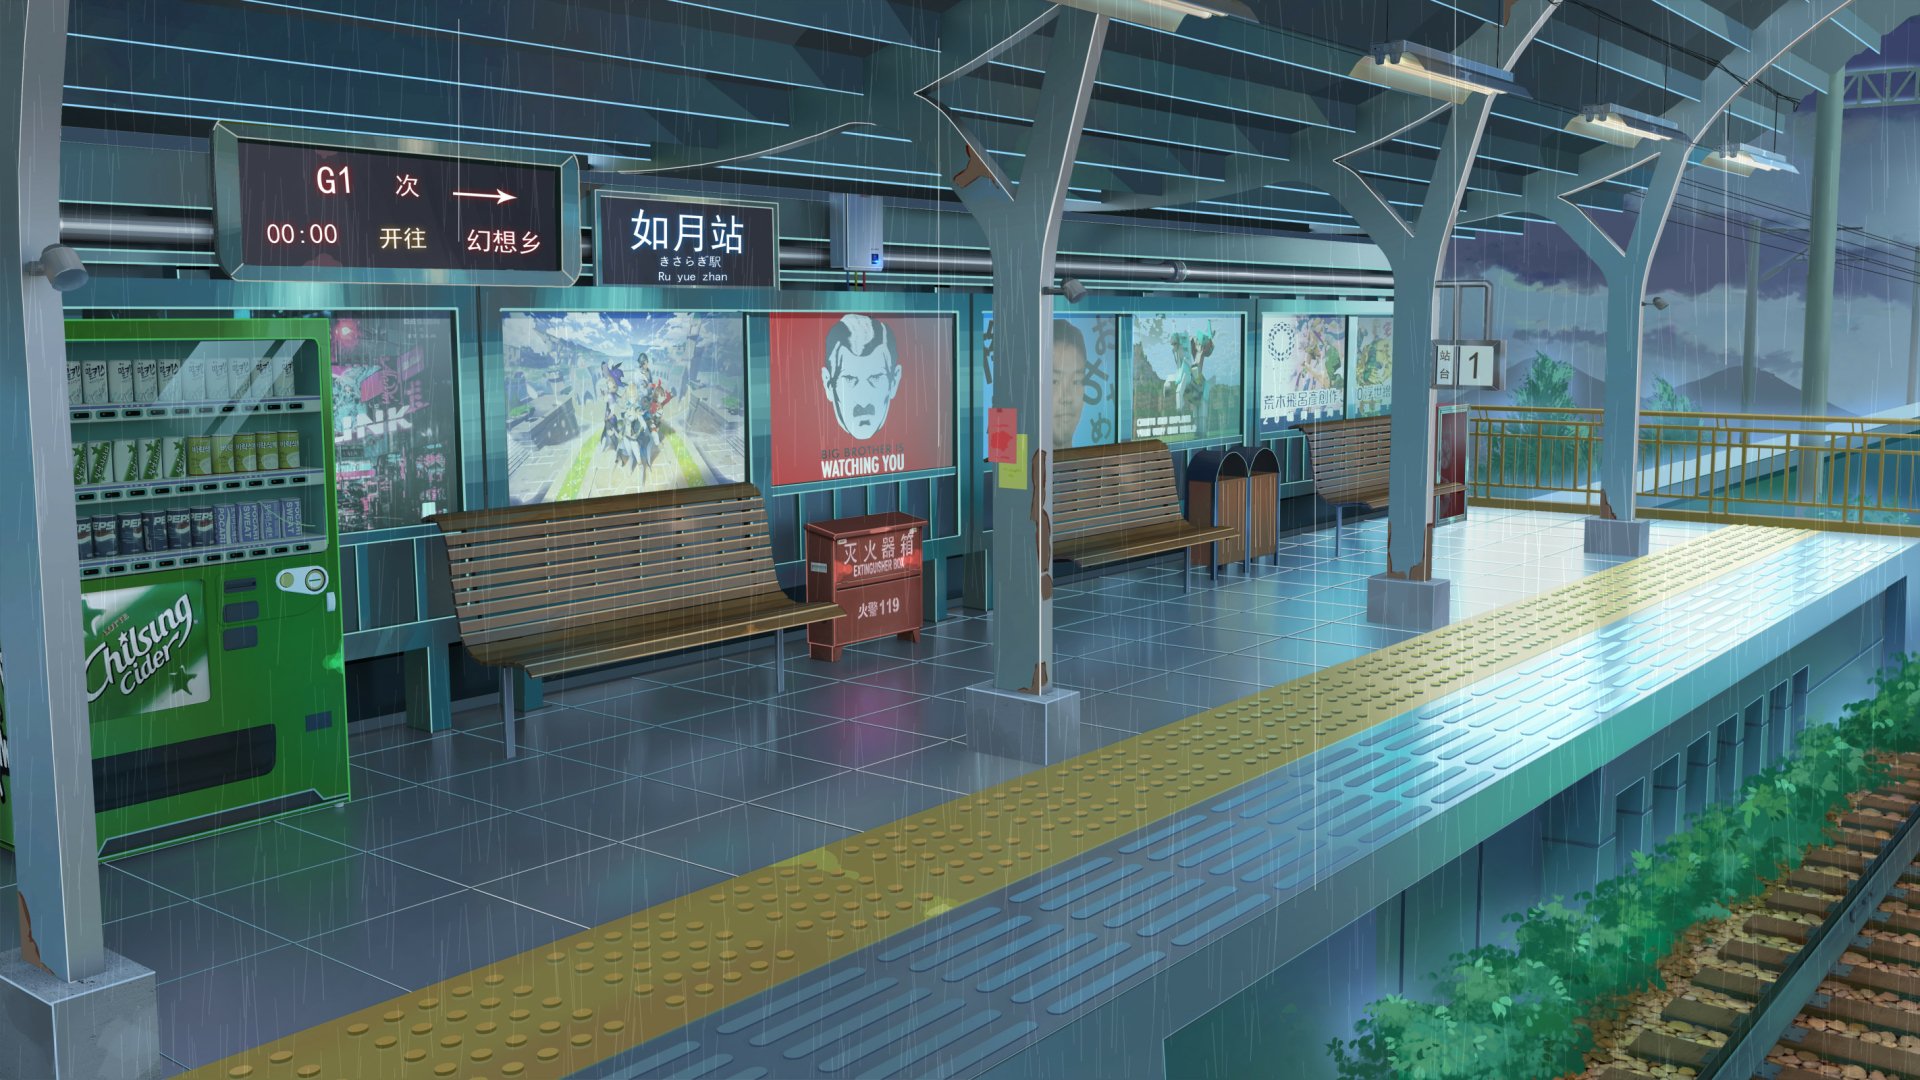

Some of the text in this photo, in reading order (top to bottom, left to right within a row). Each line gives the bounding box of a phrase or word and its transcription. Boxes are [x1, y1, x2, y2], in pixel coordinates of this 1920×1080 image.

[316, 165, 420, 198] G1 次
[267, 223, 541, 254] 00:00 开往 幻想乡
[630, 208, 744, 254] 如月站
[658, 271, 728, 282] Ru yue zhan
[659, 256, 722, 268] きさらぎ駅
[1440, 350, 1451, 379] 站台
[1469, 352, 1479, 379] 1
[821, 443, 905, 459] BIG BROTHER IS
[821, 453, 905, 478] WATCHING YOU
[844, 533, 914, 565] 灭火器箱
[85, 593, 193, 703] Chilsung
[120, 631, 180, 695] Cider
